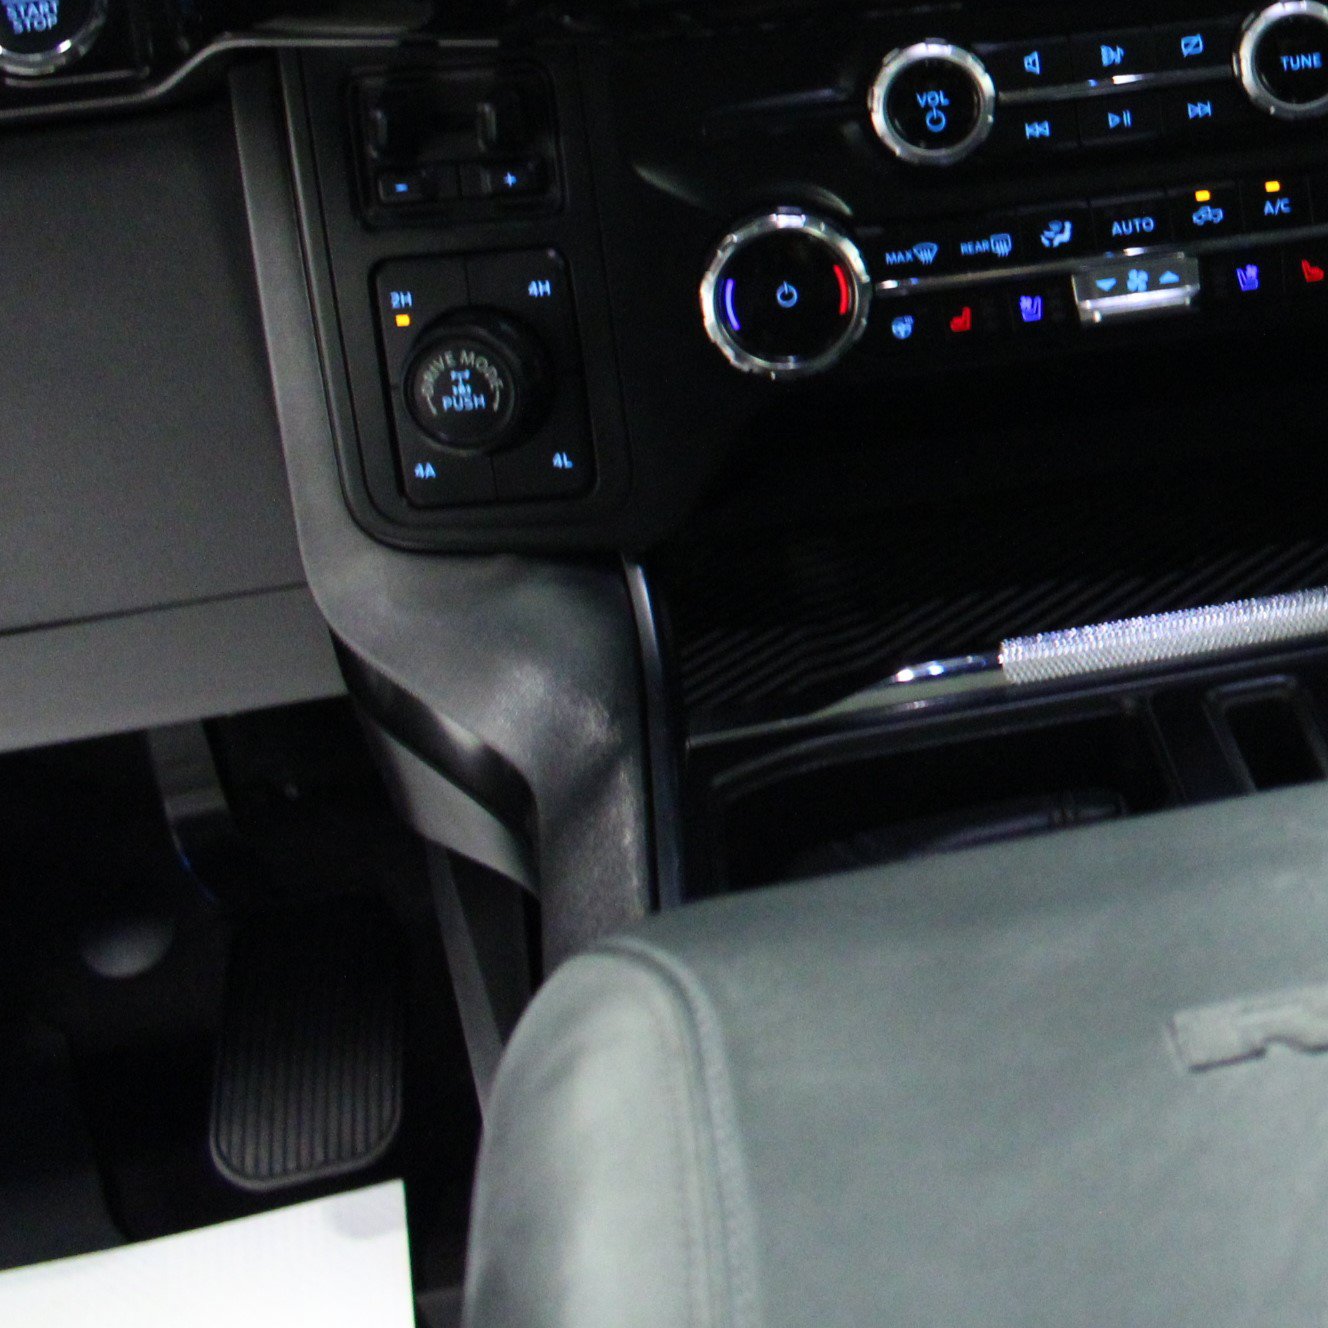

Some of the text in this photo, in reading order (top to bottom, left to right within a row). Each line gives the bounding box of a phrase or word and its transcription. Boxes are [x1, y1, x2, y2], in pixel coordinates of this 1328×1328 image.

[7, 0, 58, 21] START
[13, 14, 58, 35] STOP
[1280, 51, 1323, 72] TUNE
[916, 89, 949, 109] VOL
[1263, 199, 1291, 217] A/C
[1111, 217, 1154, 237] AUTO
[885, 249, 914, 266] MAX
[960, 239, 989, 257] REAR
[527, 279, 551, 298] 4H
[390, 291, 413, 309] 2H
[442, 393, 487, 413] PUSH
[551, 451, 573, 470] 4L
[413, 462, 437, 480] 4A
